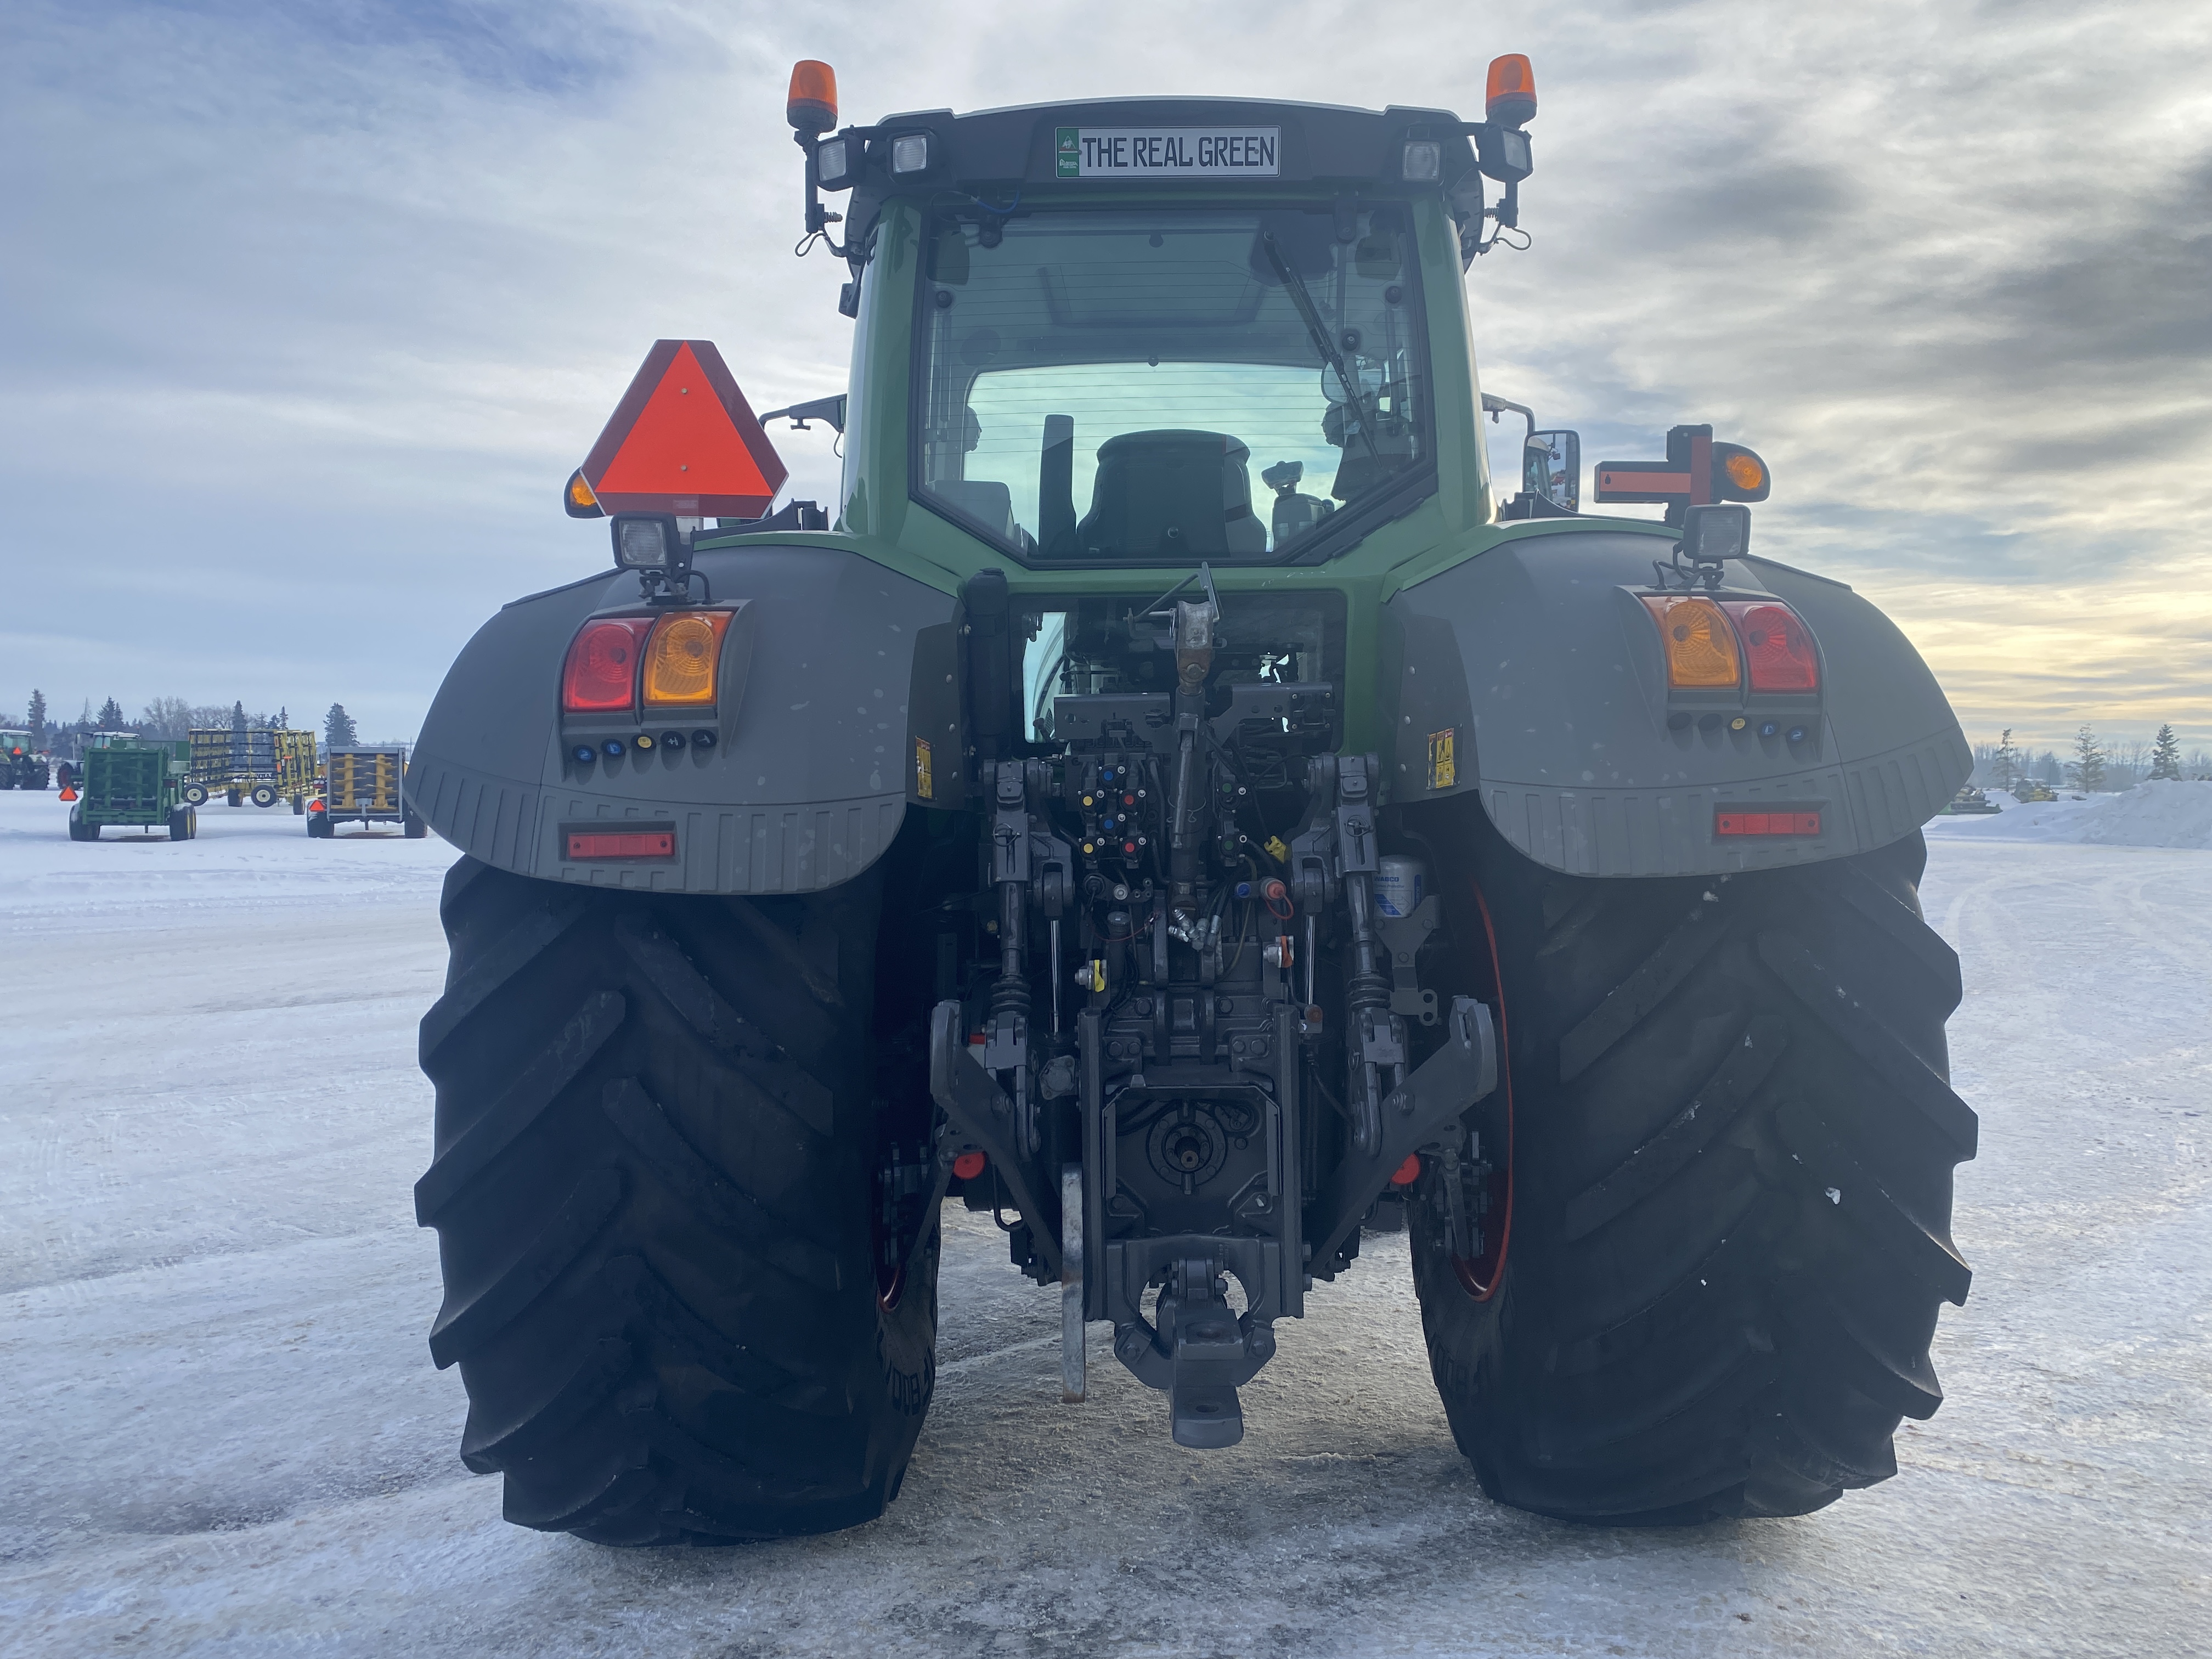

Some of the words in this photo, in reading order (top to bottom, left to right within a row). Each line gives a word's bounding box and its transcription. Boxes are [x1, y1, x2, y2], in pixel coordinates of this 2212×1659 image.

[1082, 137, 1128, 168] THE
[1133, 137, 1193, 167] REAL
[1198, 136, 1275, 167] GREEN
